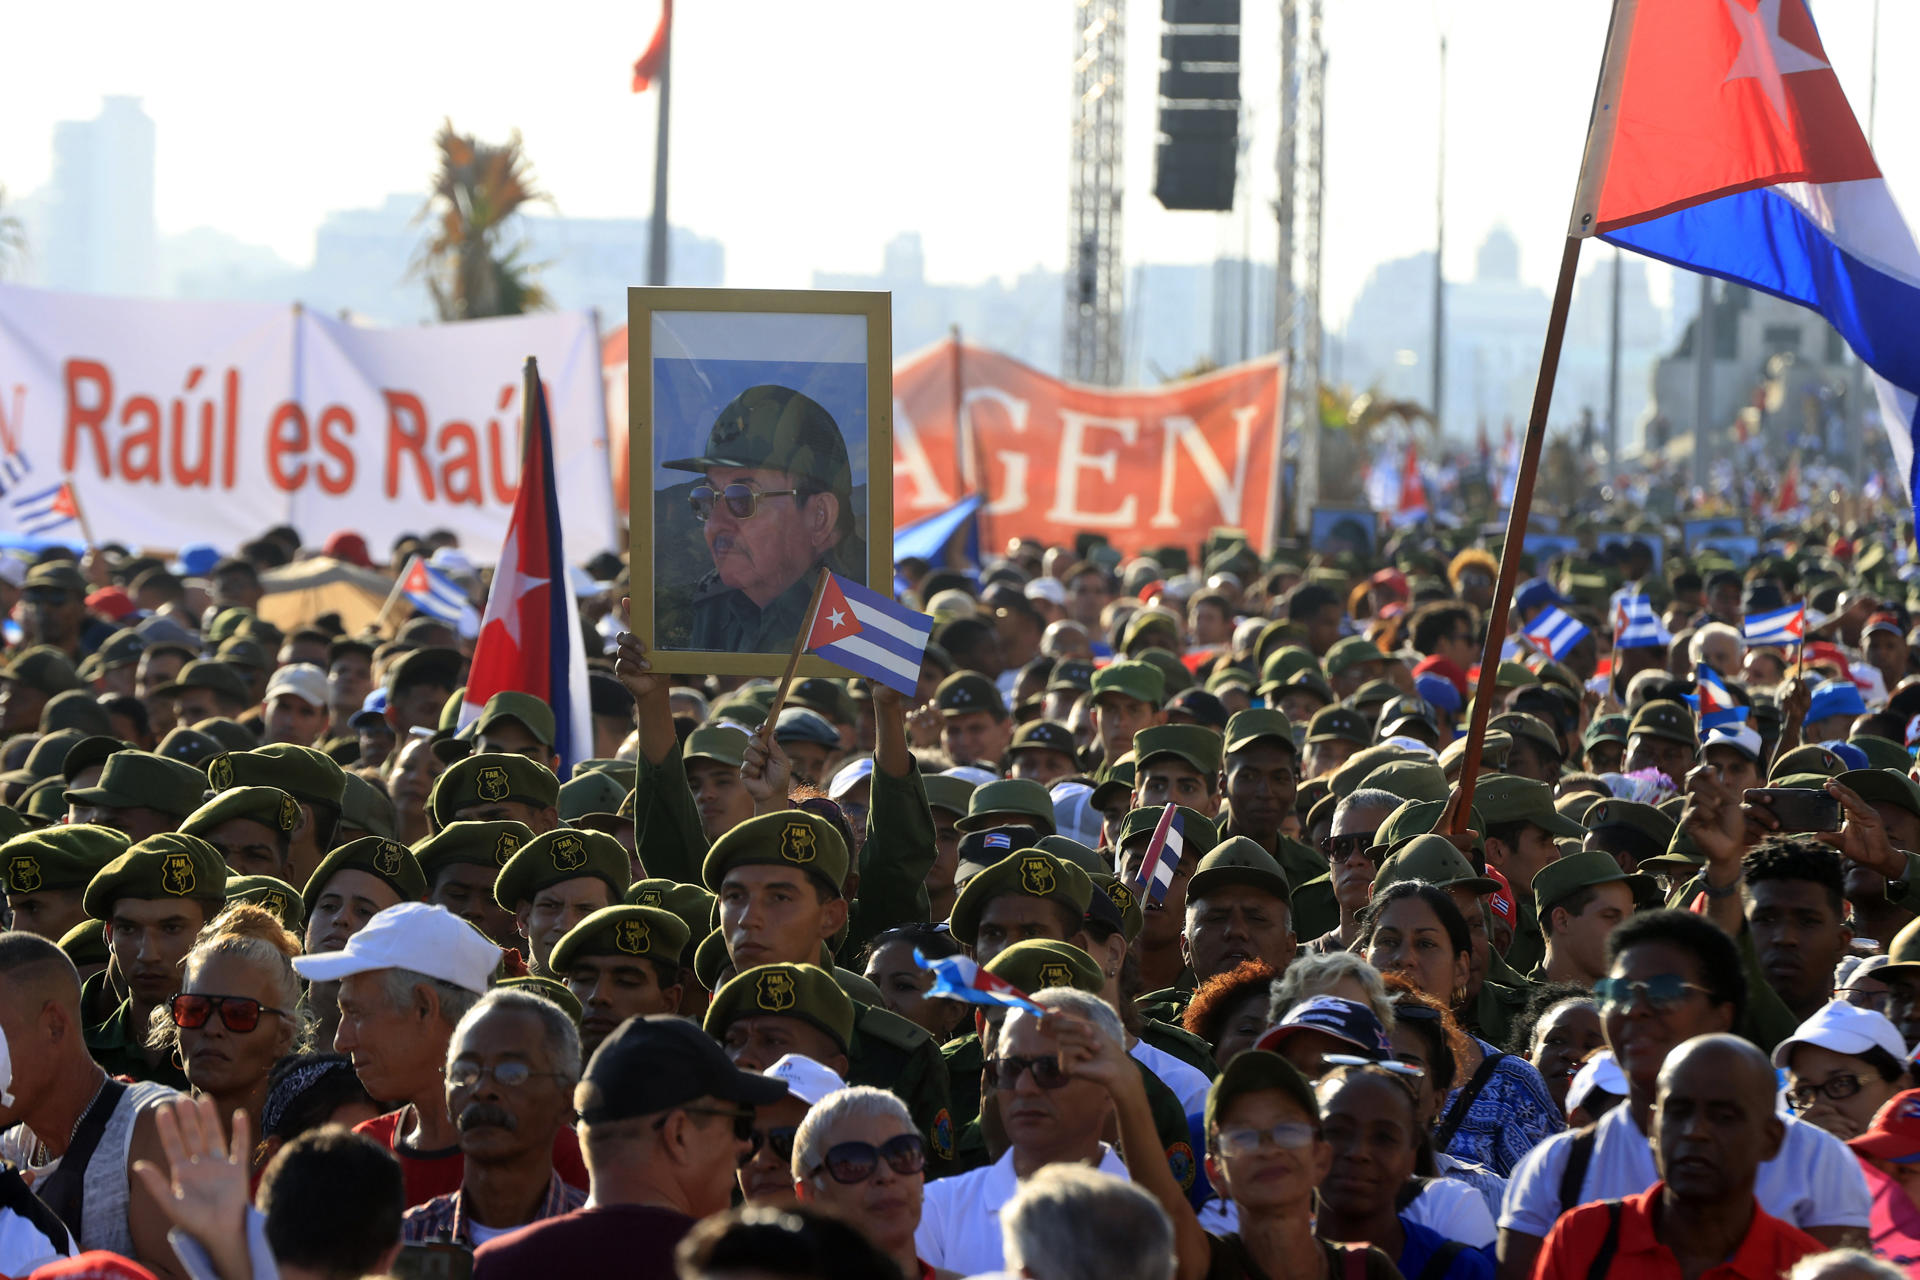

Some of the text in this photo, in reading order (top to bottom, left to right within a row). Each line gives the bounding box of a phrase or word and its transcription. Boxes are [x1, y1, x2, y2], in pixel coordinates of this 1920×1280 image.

[61, 359, 240, 490] Raúl
[265, 400, 357, 496] es
[381, 376, 553, 508] Raú
[485, 771, 499, 779] FAR
[792, 828, 805, 837] FAR
[386, 844, 399, 853] FAR
[558, 839, 571, 849] FAR
[17, 860, 31, 869] FAR
[172, 860, 185, 868] FAR
[1028, 861, 1043, 870] FAR
[626, 921, 640, 929] FAR
[1047, 967, 1062, 976] FAR
[767, 975, 784, 985] FAR
